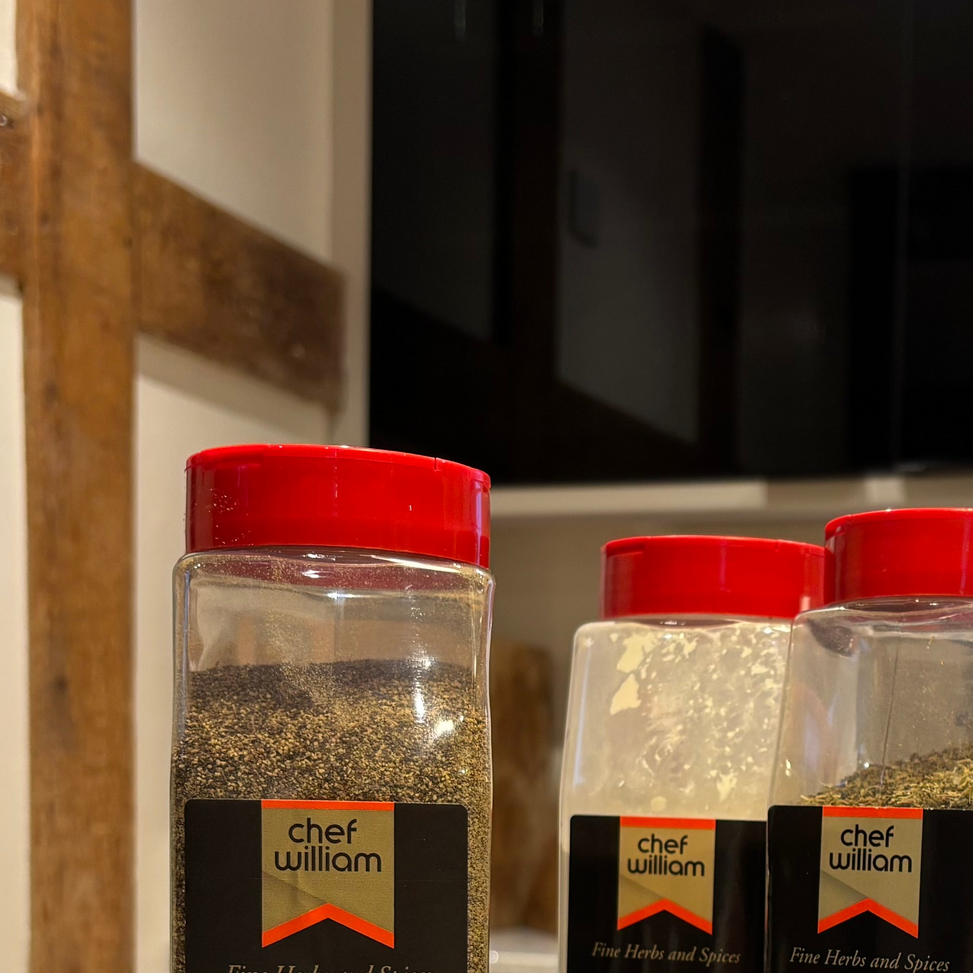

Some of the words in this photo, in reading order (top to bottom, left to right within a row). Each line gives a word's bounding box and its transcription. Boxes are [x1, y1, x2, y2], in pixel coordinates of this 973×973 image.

[288, 818, 358, 844] chef
[841, 824, 895, 847] chef
[638, 834, 688, 855] chef
[274, 846, 382, 872] william
[628, 855, 705, 876] william
[829, 848, 912, 872] william
[592, 942, 620, 958] Fine
[624, 944, 664, 960] Herbs
[668, 946, 697, 962] and
[699, 948, 741, 967] Spices
[789, 947, 821, 964] Fine
[824, 949, 867, 967] Herbs
[870, 953, 901, 970] and
